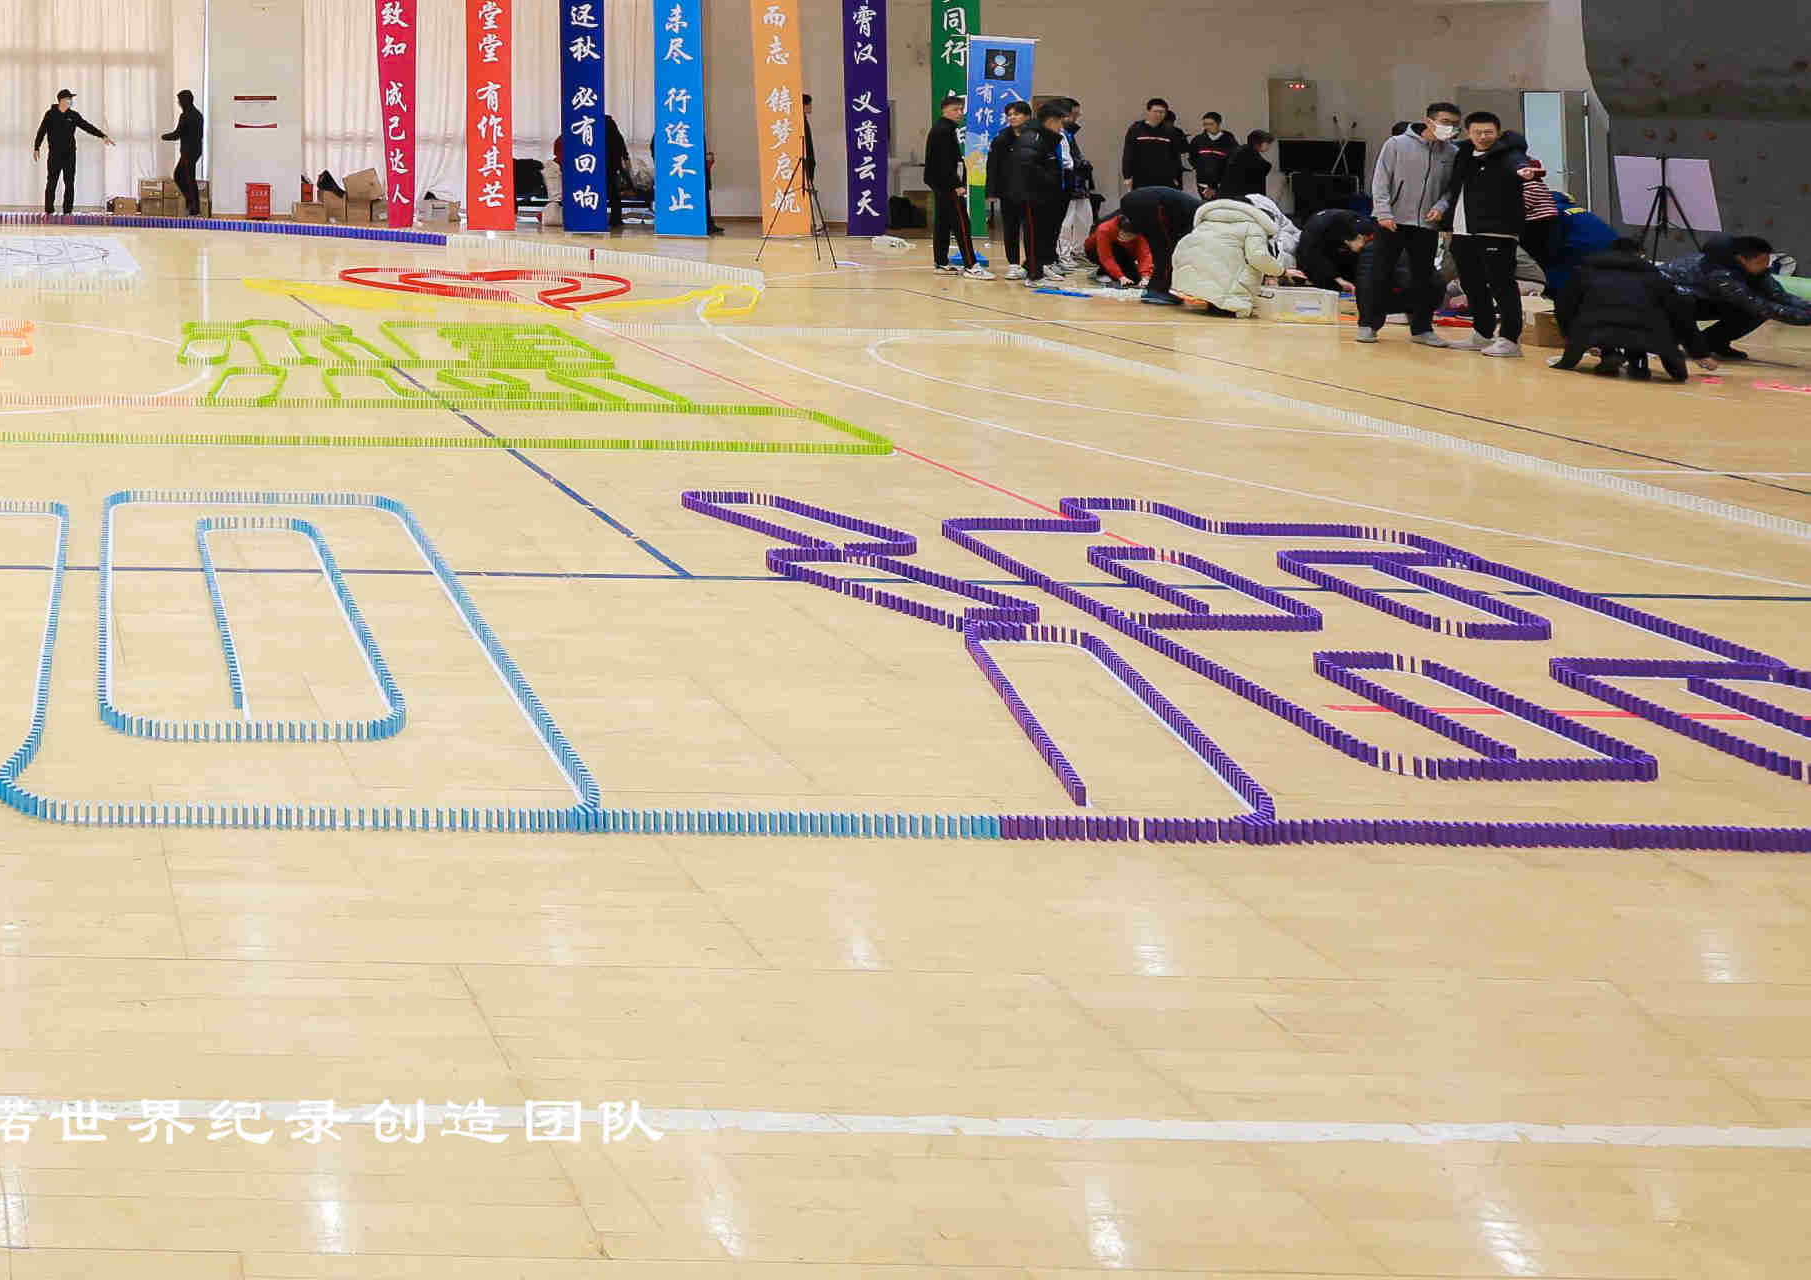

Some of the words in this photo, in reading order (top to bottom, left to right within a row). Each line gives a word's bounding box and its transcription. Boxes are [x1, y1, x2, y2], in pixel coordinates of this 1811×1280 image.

[385, 81, 410, 205] 成己达人
[475, 81, 506, 208] 有作其芒
[570, 86, 600, 211] 必有回响
[664, 87, 697, 212] 行途不止
[765, 85, 801, 214] 铸梦启航
[852, 90, 882, 217] 义薄云天
